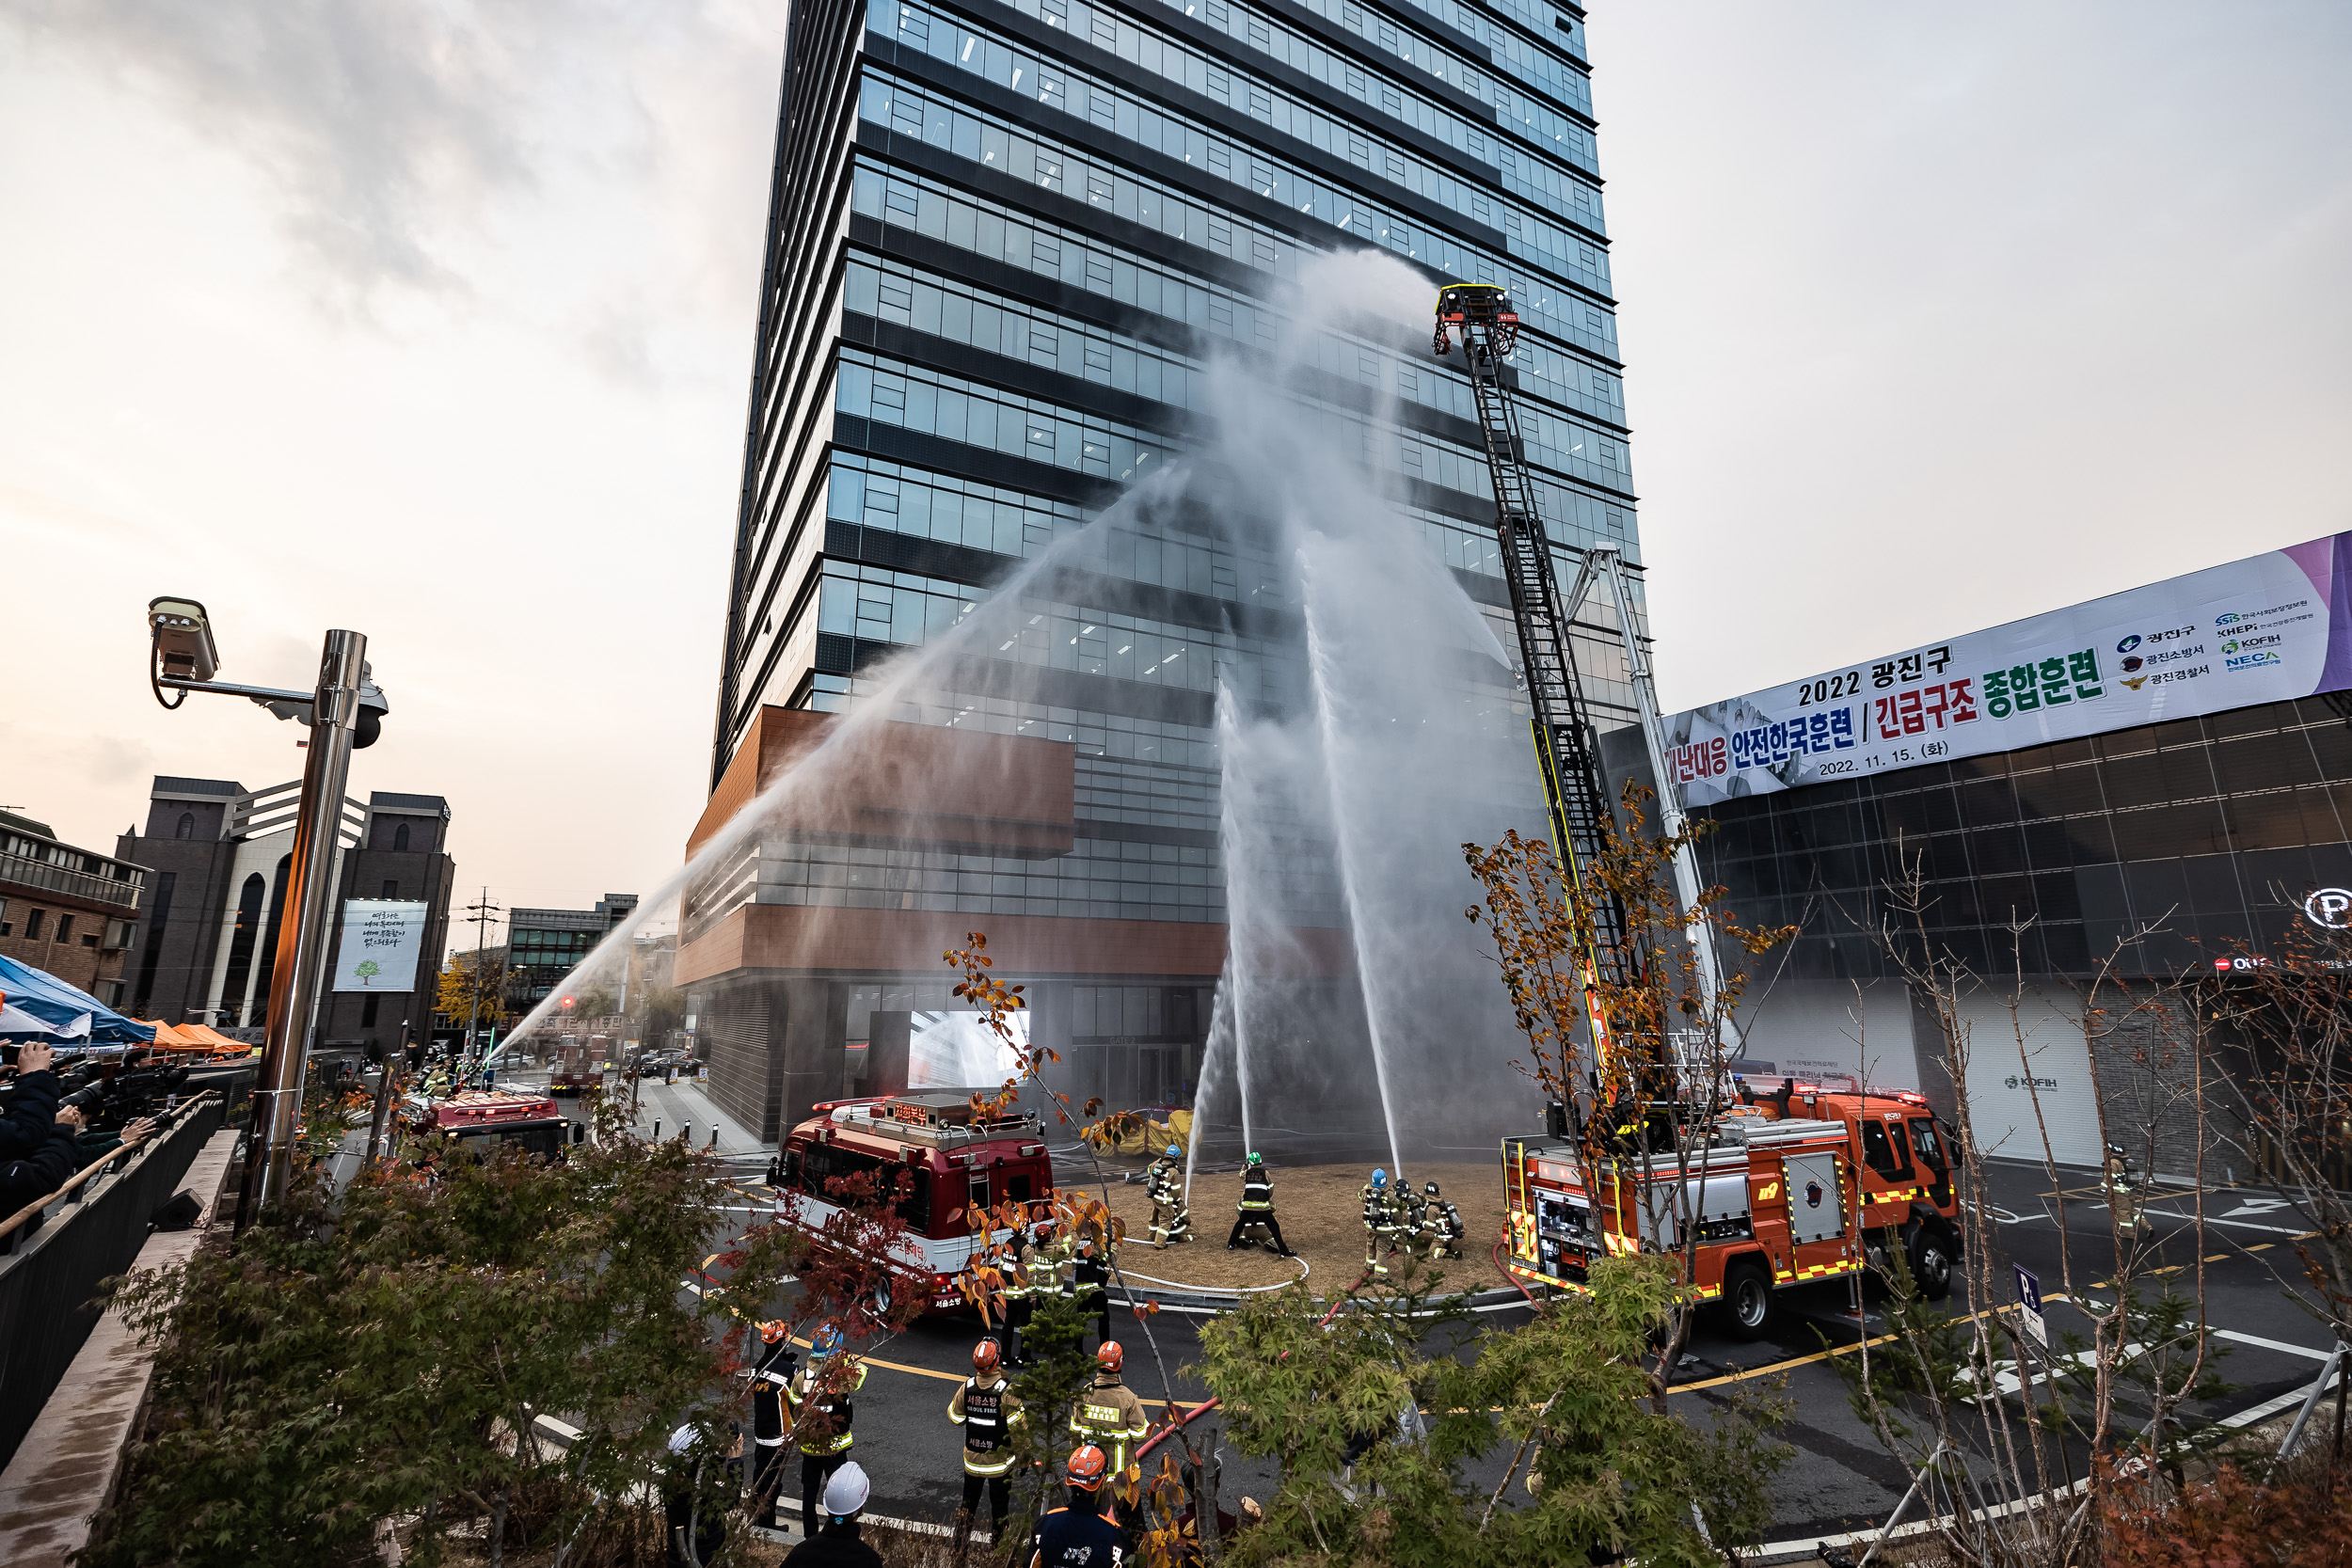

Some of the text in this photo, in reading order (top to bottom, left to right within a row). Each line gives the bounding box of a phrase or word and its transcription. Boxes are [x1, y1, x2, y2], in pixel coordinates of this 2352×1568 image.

[2241, 600, 2308, 620] 한국사회보장정보원
[2146, 625, 2197, 643] 광진구
[2241, 634, 2281, 648] KOFIH
[2146, 644, 2205, 665] 광진소방서
[2225, 652, 2280, 667] NECA
[1799, 645, 1952, 706] 2022 광진구
[2150, 665, 2211, 685] 광진경찰서
[1731, 706, 1855, 769] 안전한국훈련
[1875, 677, 1978, 739] 긴급구조
[1982, 647, 2104, 719] 종합훈련
[1819, 739, 1949, 776] 2022. 11. 15. (화)
[1758, 1181, 1779, 1201] 119
[2020, 1274, 2030, 1304] P
[935, 1297, 961, 1308] 서울소방
[967, 1395, 998, 1407] 서울소방
[969, 1437, 993, 1449] 서울소방
